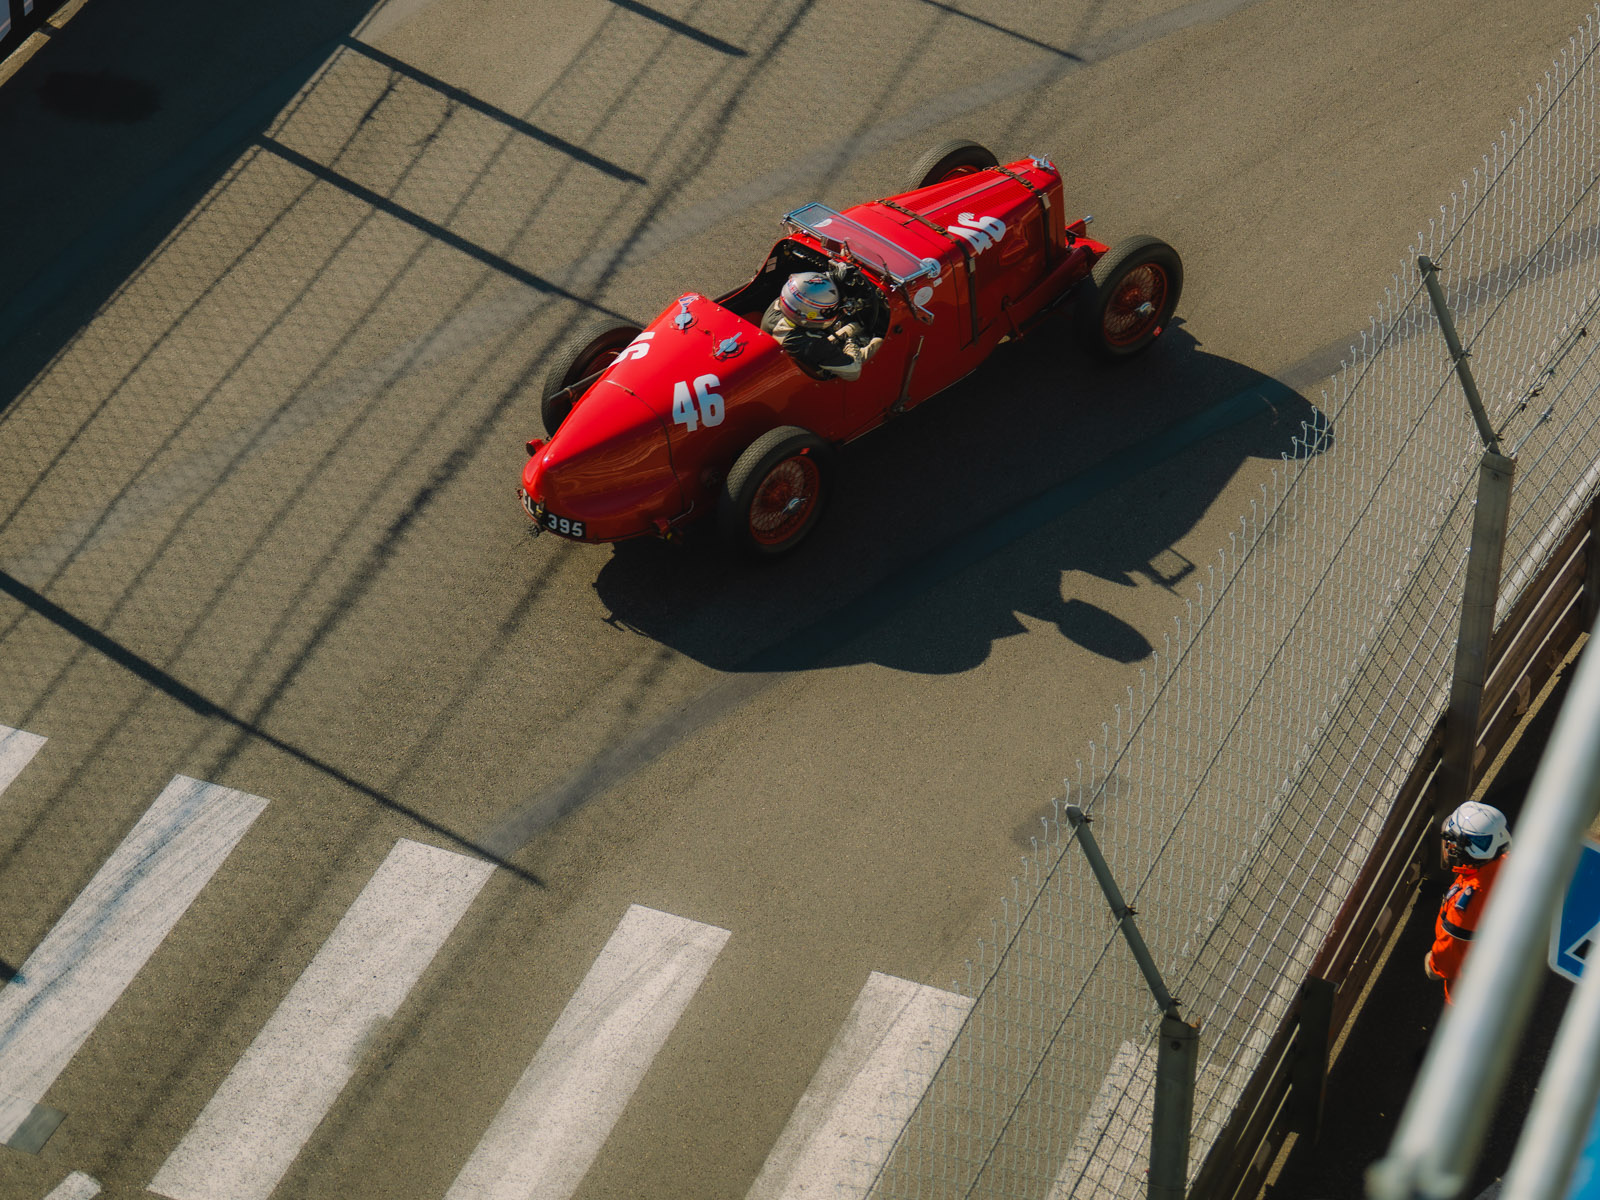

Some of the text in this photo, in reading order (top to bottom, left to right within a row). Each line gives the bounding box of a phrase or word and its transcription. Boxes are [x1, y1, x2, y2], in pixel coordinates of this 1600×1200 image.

[947, 212, 1006, 255] 46
[672, 373, 725, 433] 46
[547, 513, 583, 537] 395
